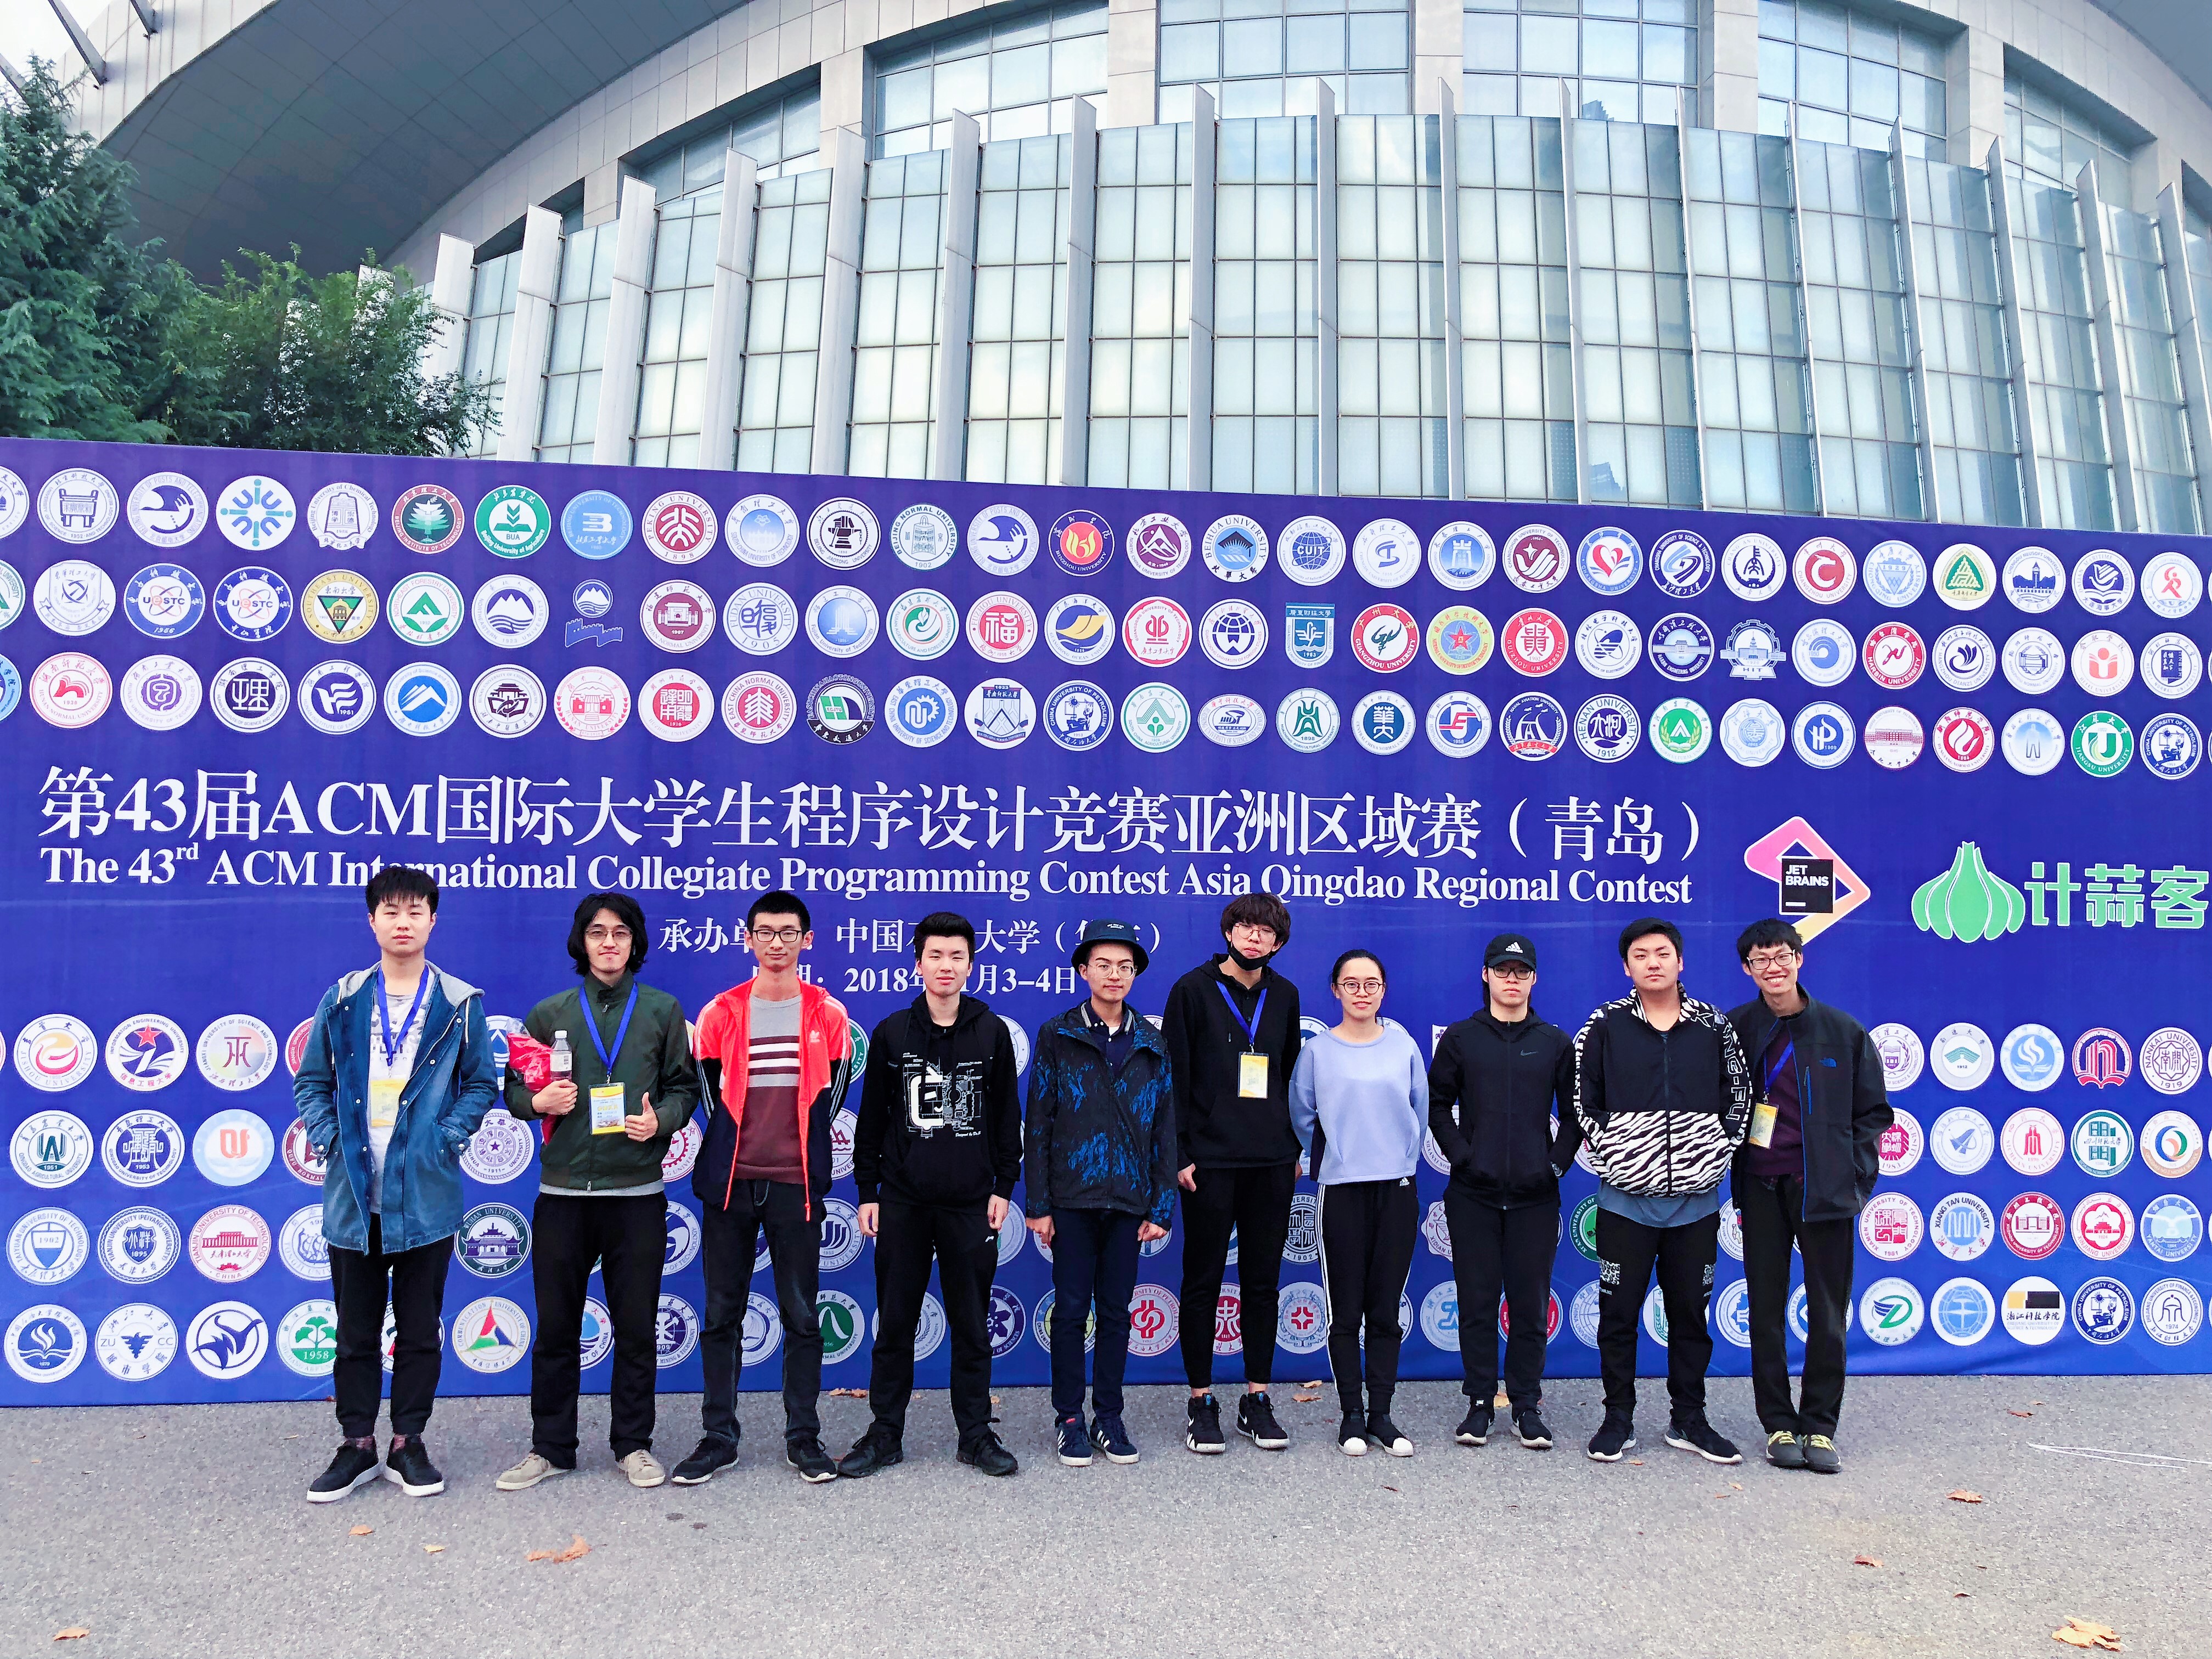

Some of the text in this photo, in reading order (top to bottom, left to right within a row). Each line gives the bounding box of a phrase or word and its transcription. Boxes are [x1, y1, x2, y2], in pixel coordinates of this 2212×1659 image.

[395, 516, 404, 535] BEIJING
[400, 534, 430, 551] INSTITUTE
[438, 517, 461, 549] TECHNOLOGY
[645, 494, 714, 543] PEKING UNIVERSITY
[892, 505, 956, 557] BEIJING NORMAL UNIVERSITY
[479, 528, 546, 555] Beijing University of Agriculture
[1204, 517, 1267, 561] BEIHUA UNIVERSITY
[1297, 545, 1325, 555] CUIT
[664, 551, 695, 560] 1898
[305, 573, 374, 620] SOUTHEAST UNIVERSITY
[392, 578, 458, 619] NORTHEAST FORESTRY UNIVERSITY
[1797, 571, 1851, 599] CHANGZHOU UNIVERSITY
[729, 588, 792, 629] FUDAN UNIVERSITY
[971, 596, 1033, 627] FUZHOU UNIVERSITY
[741, 636, 781, 650] 1905
[809, 624, 875, 654] Fujian University of Technology
[1354, 638, 1416, 669] GUANGZHOU UNIVERSITY
[1506, 639, 1563, 672] GUIZHOU UNIVERSITY
[1866, 656, 1922, 685] HARBIN UNIVERSITY
[726, 676, 792, 723] EAST CHINA NORMAL UNIVERSITY
[1048, 685, 1109, 729] CHINA UNIVERSITY OF PETROLEUM
[1578, 698, 1636, 741] HENAN UNIVERSITY
[1596, 748, 1617, 757] 1912
[2145, 719, 2198, 758] CHINA UNIVERSITY OF PETROLEUM
[2075, 747, 2130, 773] JIANGSU UNIVERSITY
[41, 848, 119, 883] The
[128, 842, 199, 884] 43rd
[207, 850, 319, 885] ACM
[588, 855, 770, 899] Collegiate
[779, 858, 1030, 901] Programming
[1040, 861, 1169, 894] Contest
[1177, 863, 1252, 895] Asia
[1262, 865, 1405, 905] Qingdao
[1414, 867, 1560, 907] Regional
[1569, 870, 1692, 903] Contest
[1786, 865, 1808, 874] JET
[1786, 876, 1828, 886] BRAINS
[2025, 862, 2209, 929] 计蒜客
[2145, 1032, 2198, 1070] NANKAI UNIVERSITY
[2159, 1080, 2183, 1088] 1919
[1862, 1197, 1920, 1252] XIAMEN UNIVERSITY OF TECHNOLOGY
[1933, 1197, 1991, 1229] XIANG TAN UNIVERSITY
[10, 1211, 86, 1264] TAIYUAN UNIVERSITY OF TECHNOLOGY
[190, 1206, 270, 1264] TIANJIN UNIVERSITY OF TECHNOLOGY
[2076, 1233, 2130, 1257] XINJIANG UNIVERSITY
[215, 1271, 242, 1279] CHINA
[2076, 1282, 2130, 1322] CHINA UNIVERSITY OF PETROLEUM
[100, 1337, 173, 1347] ZU CC
[303, 1350, 329, 1359] 1958
[590, 1331, 609, 1360] OF CHINA
